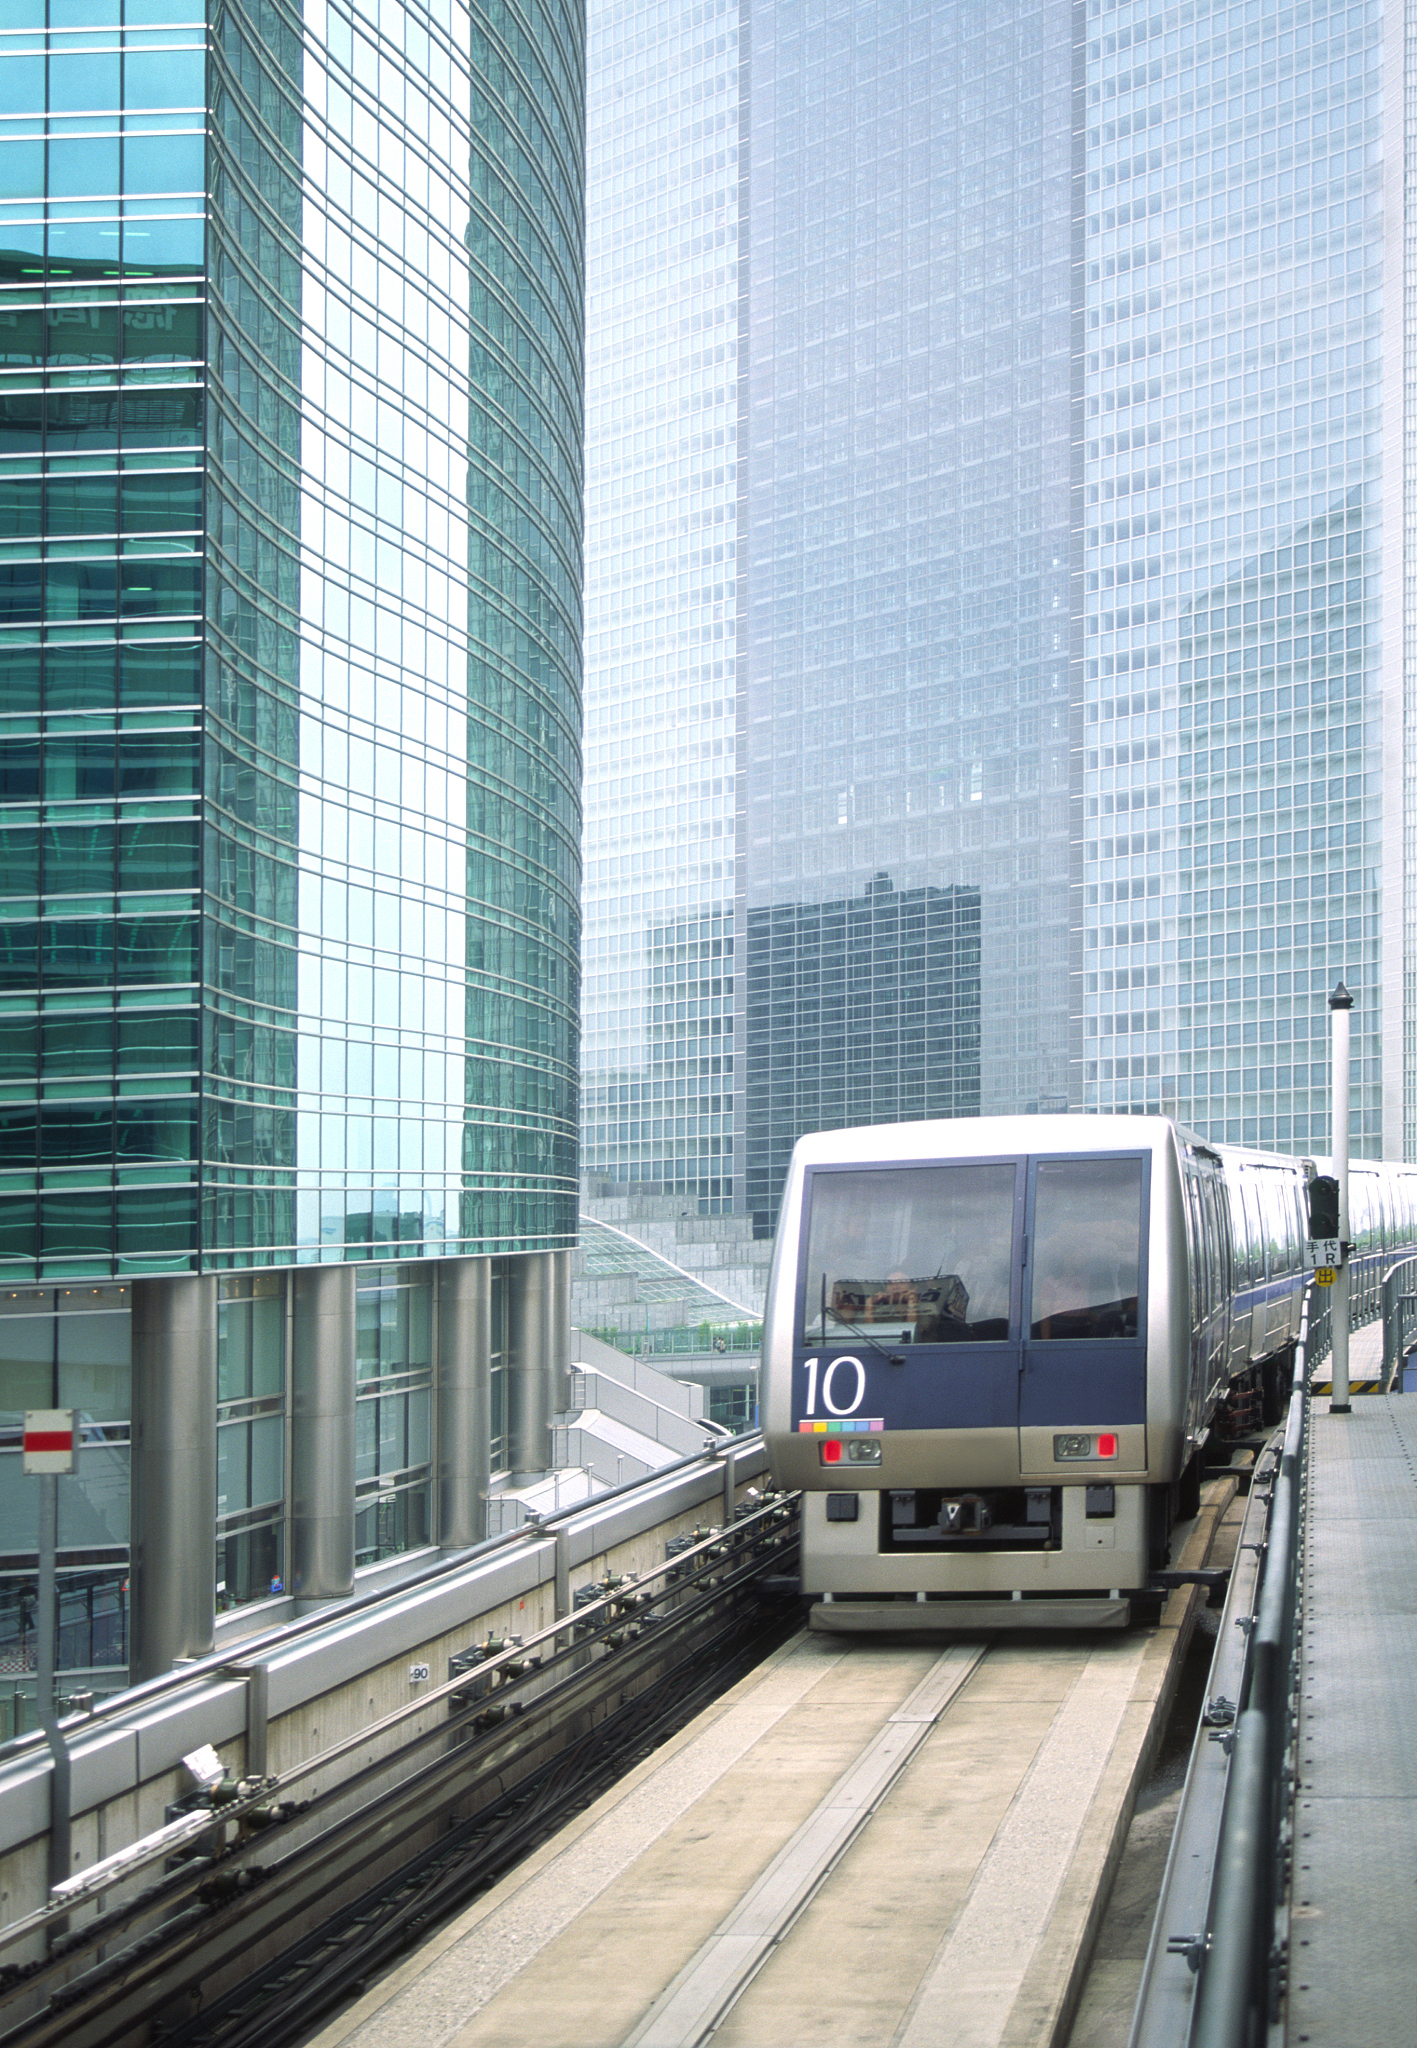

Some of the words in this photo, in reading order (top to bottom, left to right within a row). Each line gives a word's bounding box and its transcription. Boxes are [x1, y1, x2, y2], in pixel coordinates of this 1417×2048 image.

[1306, 1240, 1337, 1253] 手代
[1319, 1269, 1333, 1283] 出
[804, 1356, 866, 1415] 10
